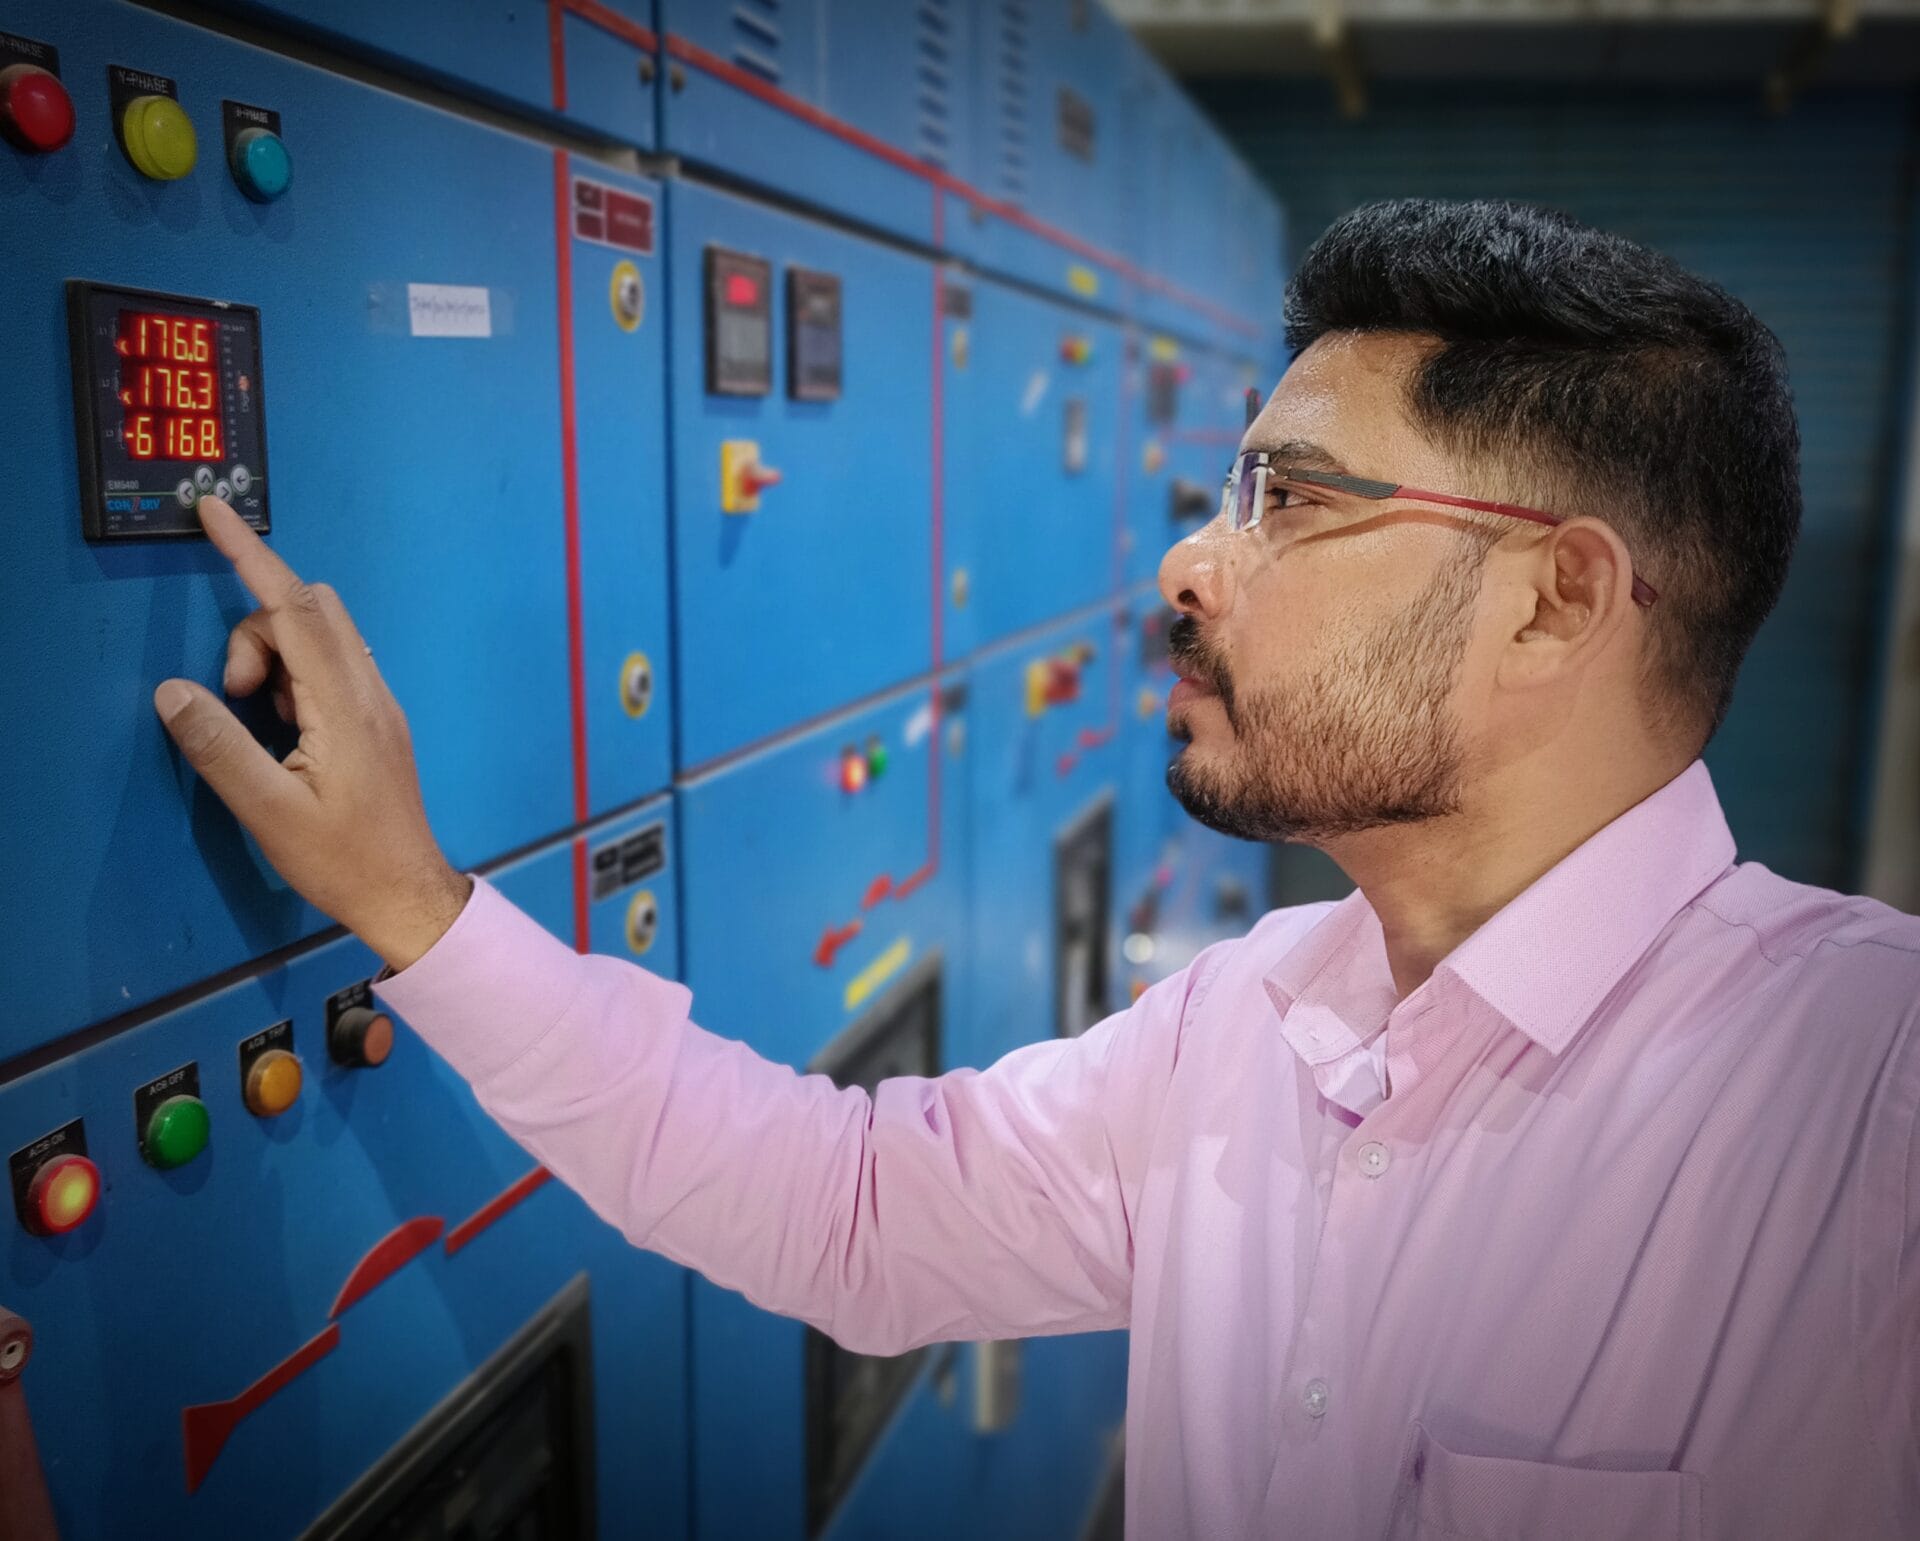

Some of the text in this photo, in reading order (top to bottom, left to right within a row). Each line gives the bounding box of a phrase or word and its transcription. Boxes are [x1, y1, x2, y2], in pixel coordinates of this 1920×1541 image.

[118, 70, 169, 94] Y-PHASE
[140, 318, 208, 362] 176.6
[144, 368, 212, 410] 176.3
[149, 1070, 186, 1096] ACB OFF
